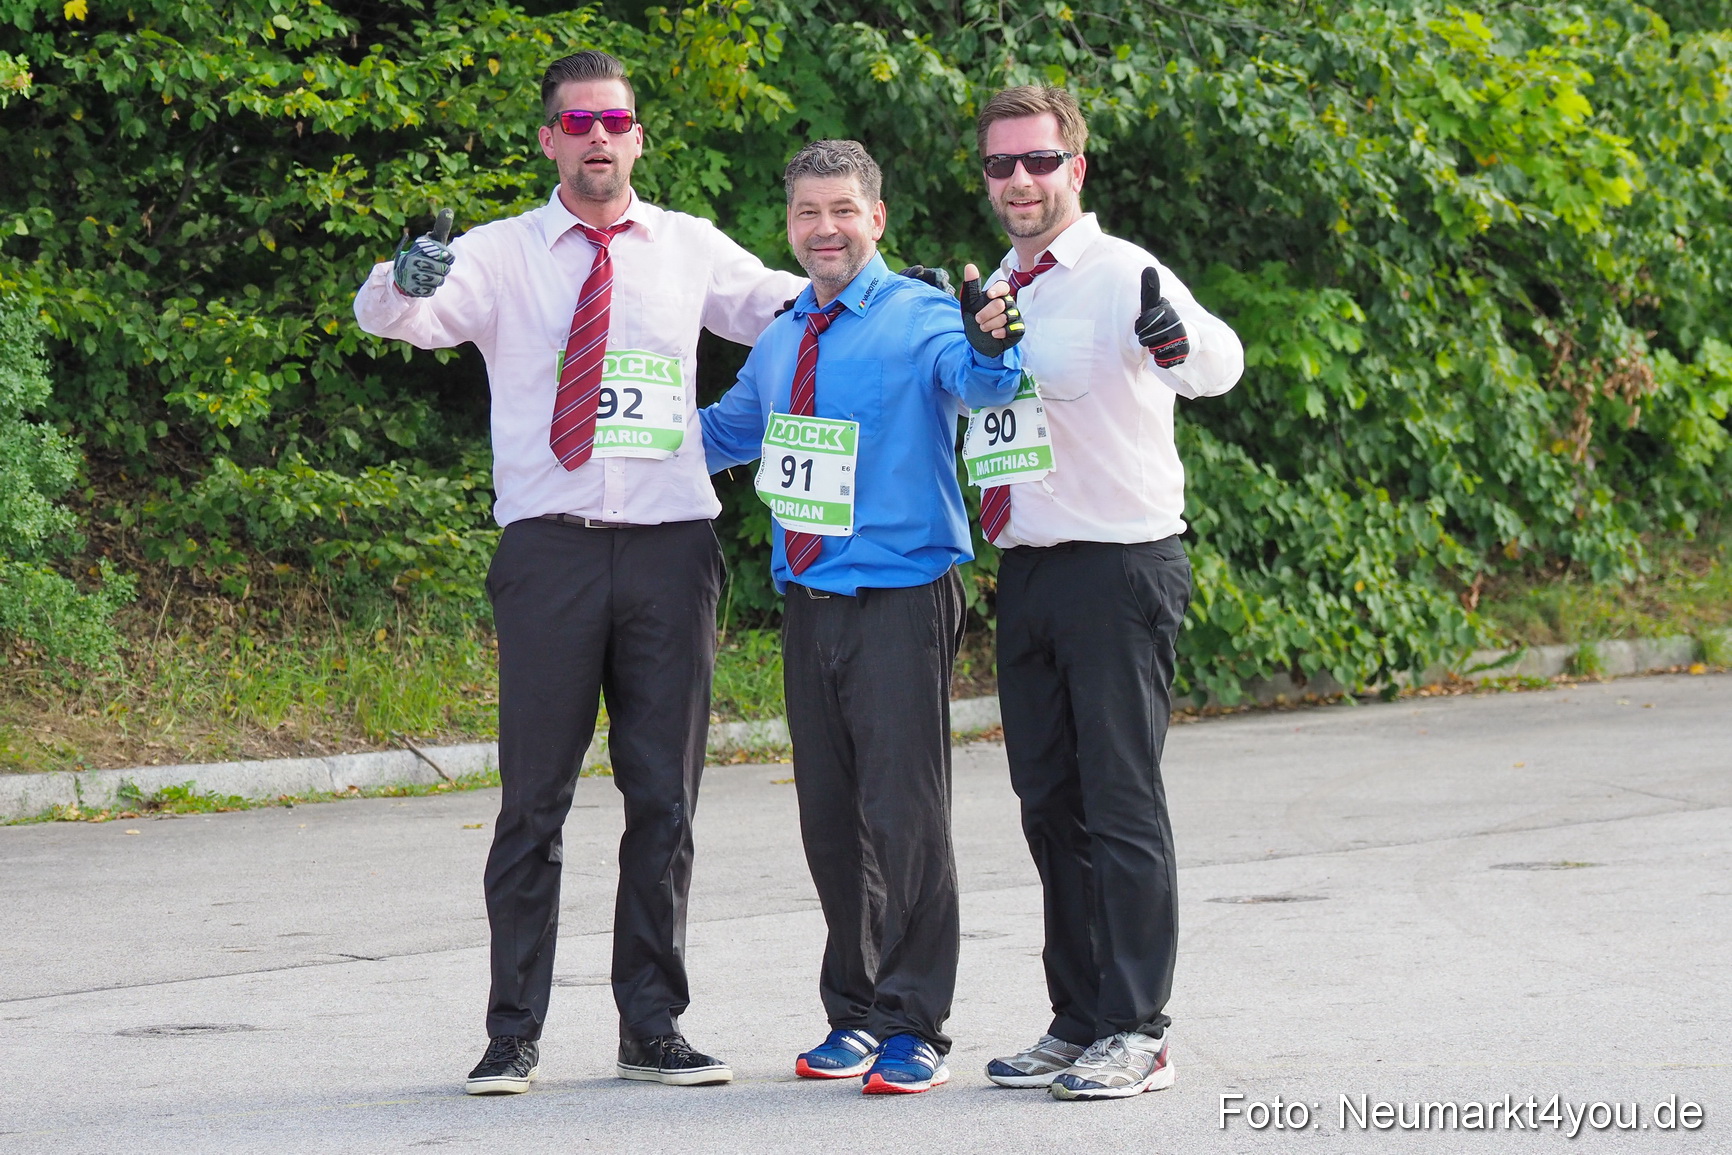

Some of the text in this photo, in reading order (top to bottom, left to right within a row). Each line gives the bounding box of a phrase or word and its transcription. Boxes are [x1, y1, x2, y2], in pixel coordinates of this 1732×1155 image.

[862, 277, 879, 301] VARIOTEC
[597, 387, 644, 420] 92
[593, 430, 652, 445] MARIO
[984, 409, 1016, 446] 90
[781, 455, 813, 491] 91
[976, 452, 1039, 476] MATTHIAS
[769, 498, 824, 521] ADRIAN
